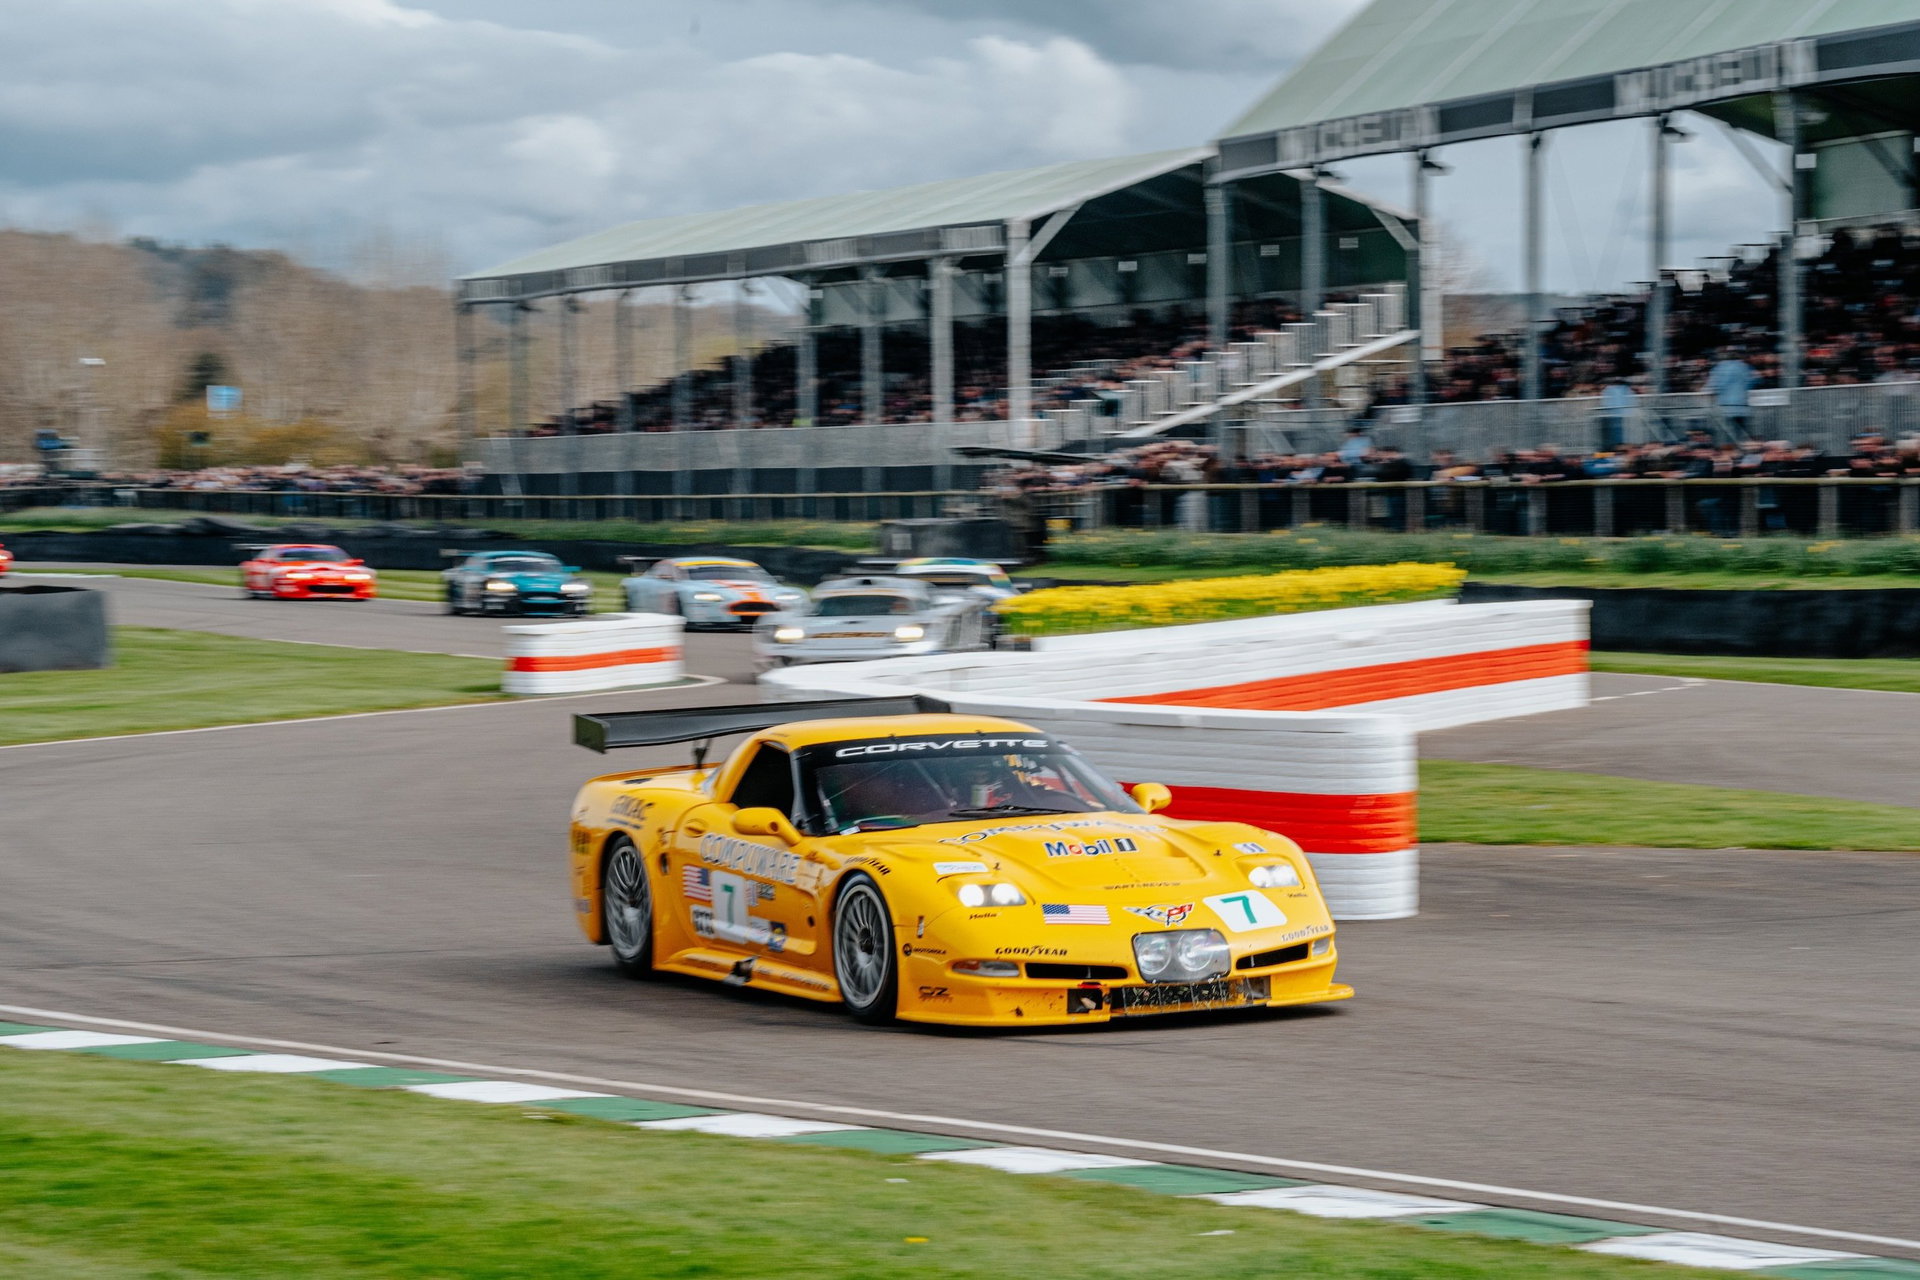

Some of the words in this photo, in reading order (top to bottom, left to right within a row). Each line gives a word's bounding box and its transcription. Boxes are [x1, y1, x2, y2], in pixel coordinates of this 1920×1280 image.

[835, 739, 1049, 758] CORVETTE
[1044, 839, 1112, 857] Mobil
[1114, 838, 1135, 851] 1
[721, 884, 735, 928] 7
[1220, 894, 1258, 924] 7
[995, 943, 1068, 957] GOODYEAR
